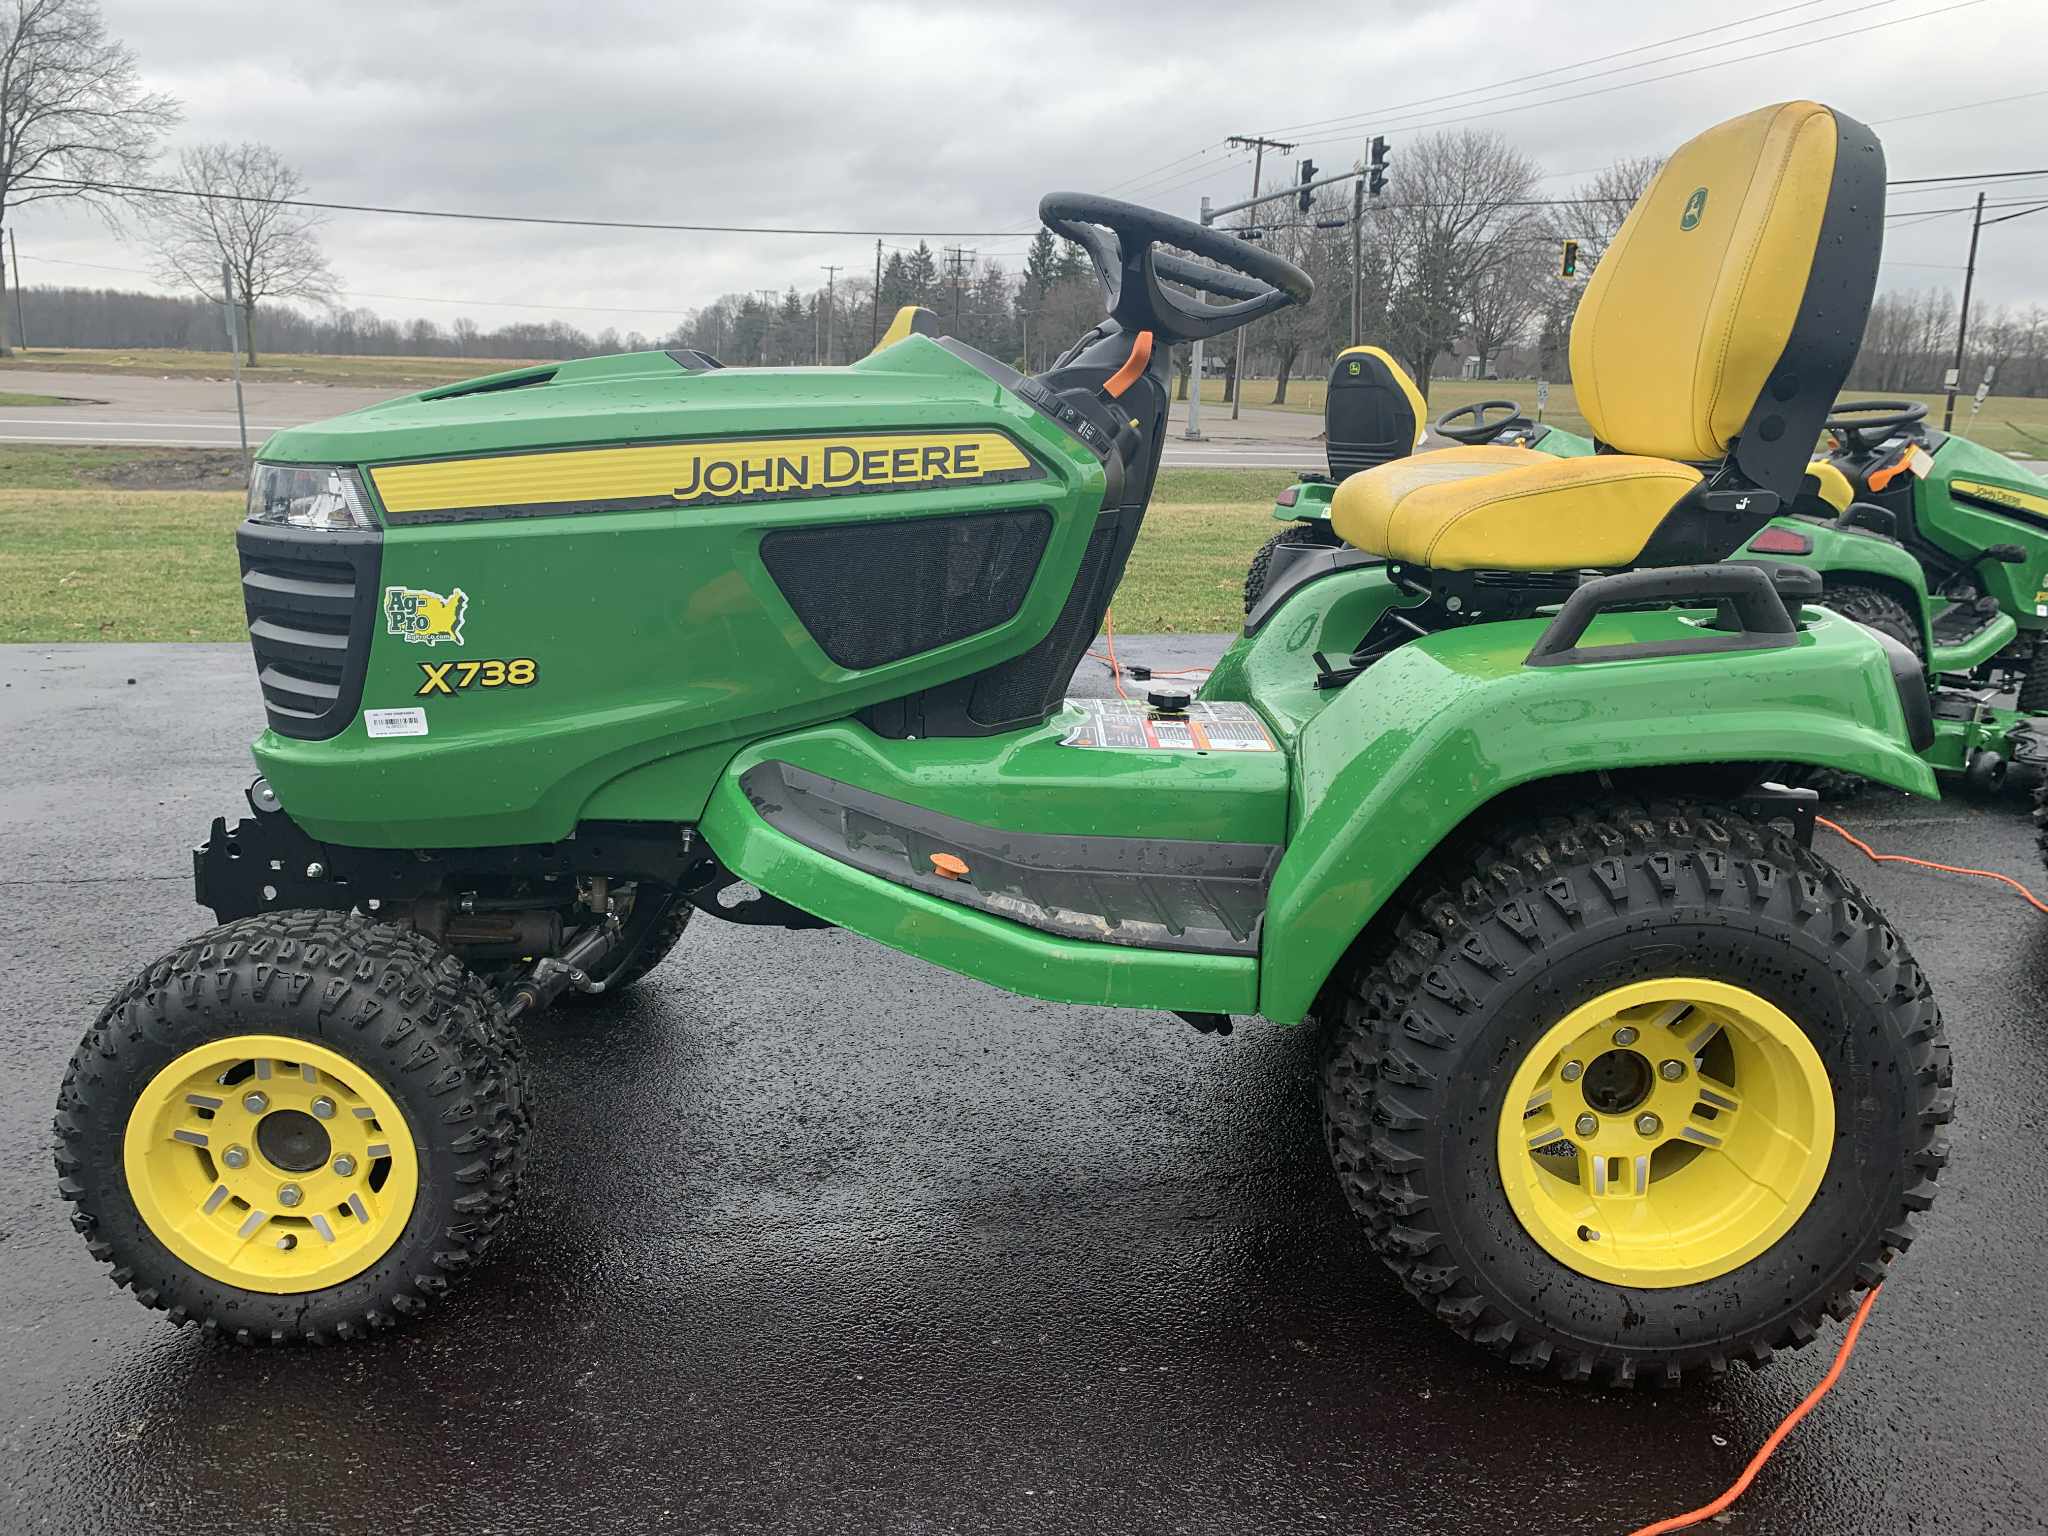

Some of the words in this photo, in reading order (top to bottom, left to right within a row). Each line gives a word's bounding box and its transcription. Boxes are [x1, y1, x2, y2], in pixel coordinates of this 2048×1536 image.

[673, 455, 808, 496] JOHN
[823, 445, 980, 483] DEERE
[389, 591, 426, 615] Ag-
[390, 611, 429, 631] Pro
[415, 658, 537, 697] X738
